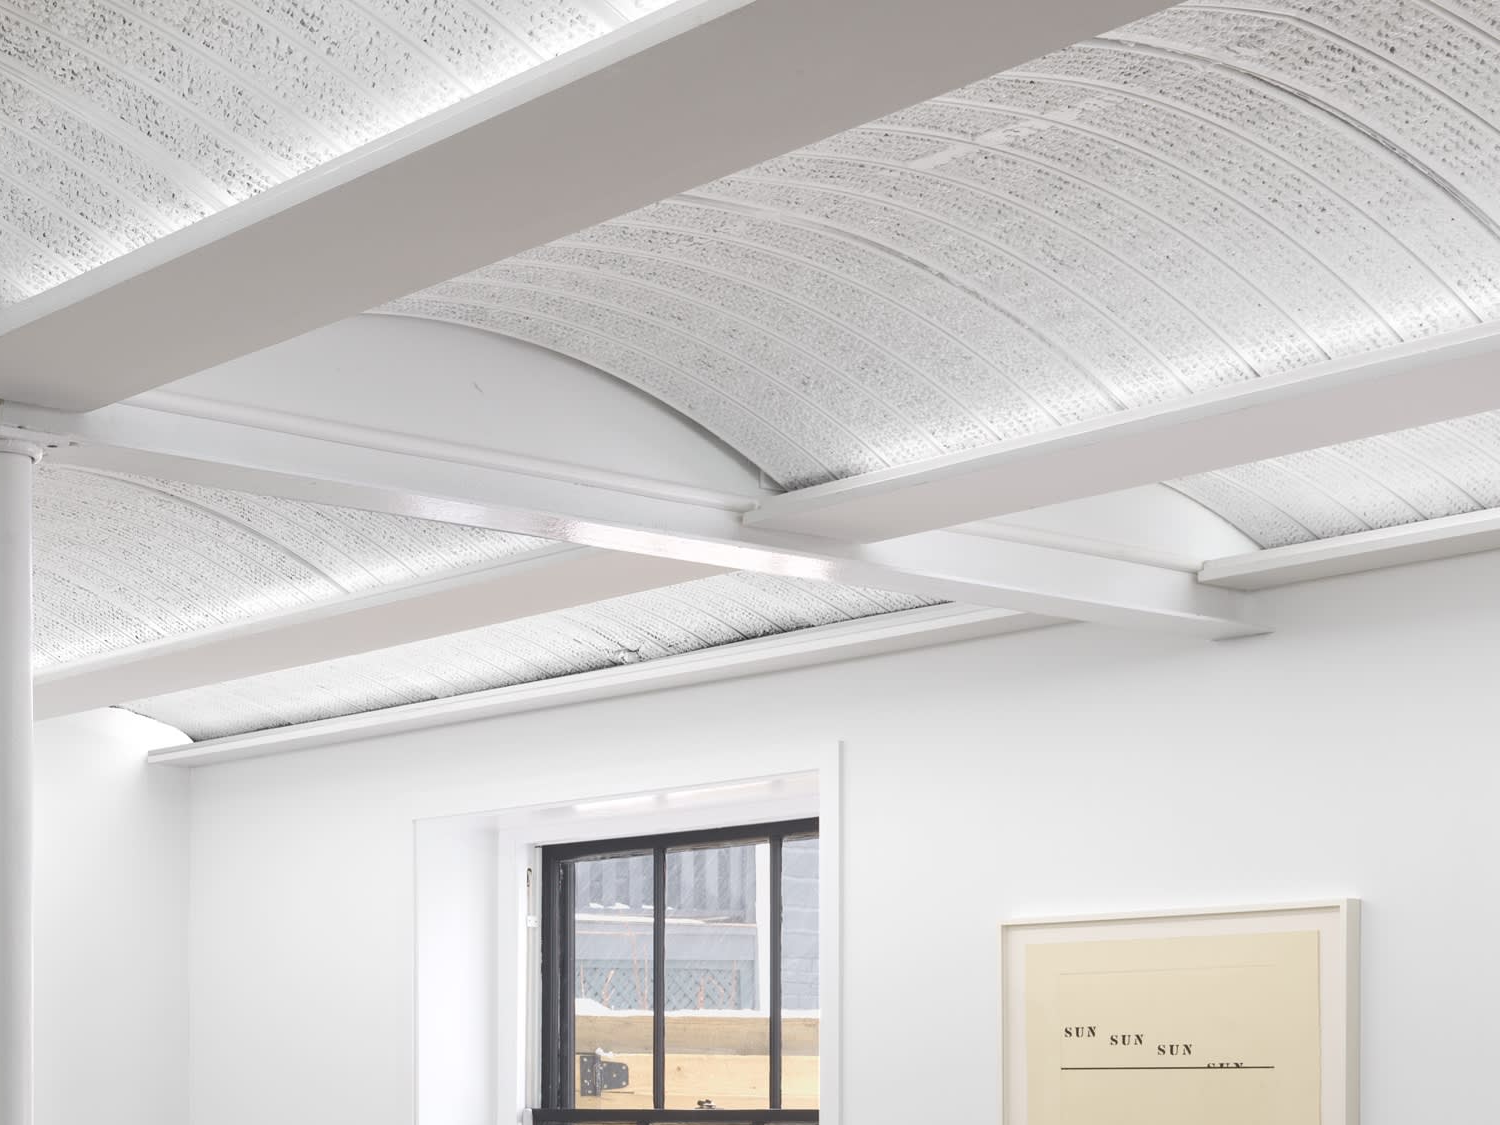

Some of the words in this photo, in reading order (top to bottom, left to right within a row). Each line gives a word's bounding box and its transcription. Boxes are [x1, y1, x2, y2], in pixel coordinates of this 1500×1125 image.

[1064, 1026, 1097, 1038] SUN
[1110, 1034, 1144, 1046] SUN
[1157, 1044, 1193, 1056] SUN
